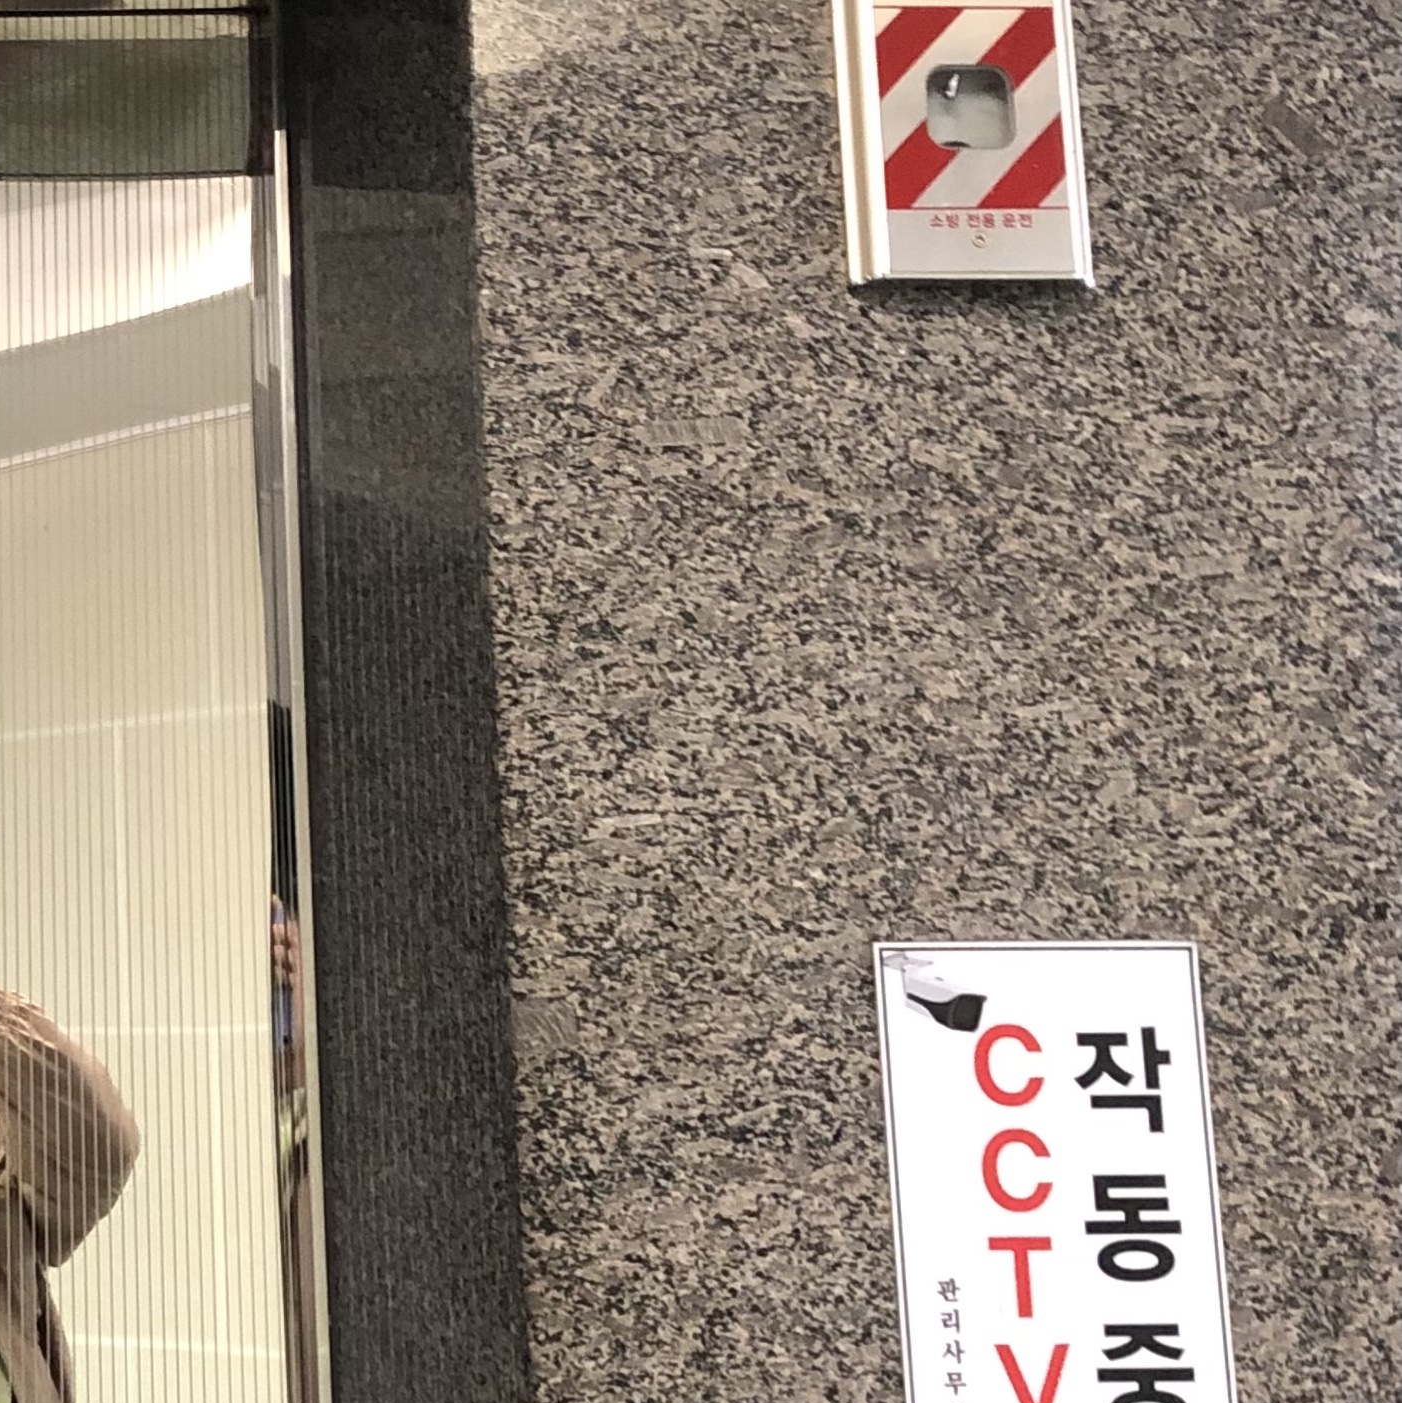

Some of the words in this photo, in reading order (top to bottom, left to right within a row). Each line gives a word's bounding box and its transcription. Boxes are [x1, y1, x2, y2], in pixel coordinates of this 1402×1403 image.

[930, 214, 960, 229] 소방
[967, 214, 996, 229] 전용
[1001, 213, 1034, 228] 운전
